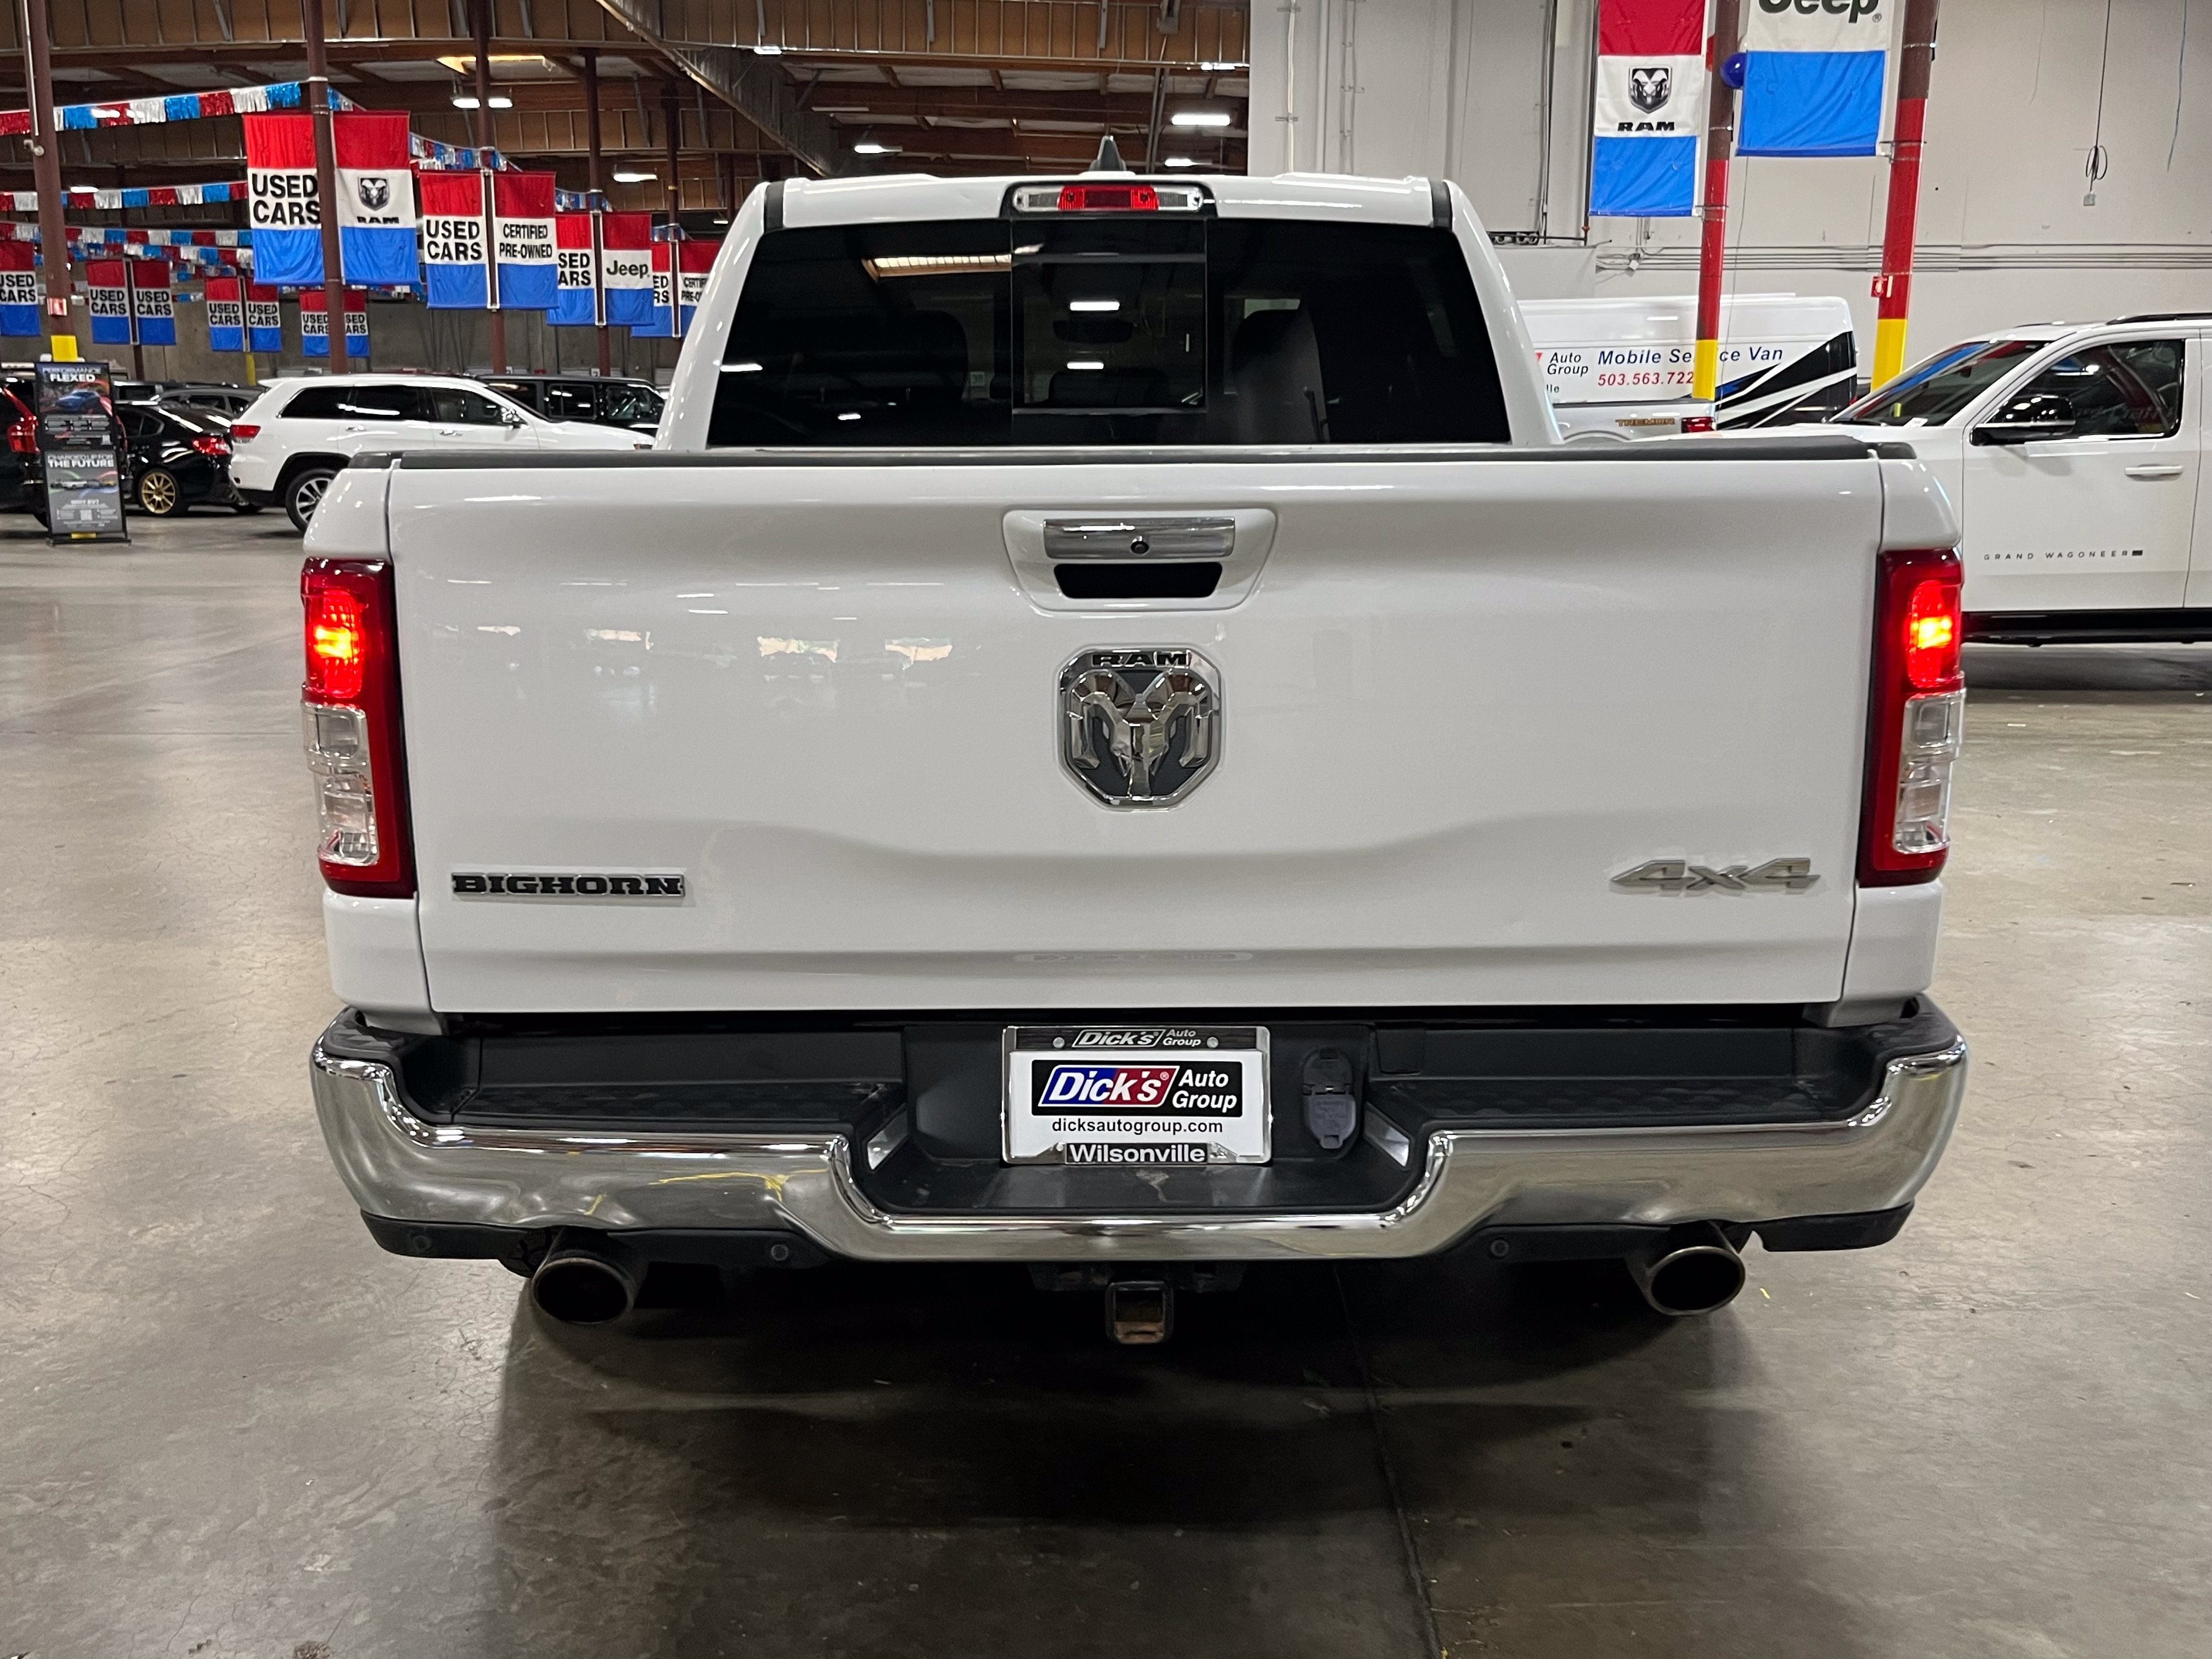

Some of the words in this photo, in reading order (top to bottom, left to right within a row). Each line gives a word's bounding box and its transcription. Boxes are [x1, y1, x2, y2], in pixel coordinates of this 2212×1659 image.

[1618, 122, 1675, 132] RAM
[252, 173, 318, 198] USED
[253, 200, 320, 225] CARS
[426, 219, 480, 240] USED
[503, 223, 548, 239] CERTIFIED
[427, 240, 482, 261] CARS
[499, 242, 552, 258] PRE-OWNED
[558, 252, 590, 269] SED
[606, 260, 648, 279] Jeep
[558, 270, 591, 286] ARS
[653, 275, 669, 289] ED
[684, 277, 708, 288] CERTIF
[0, 289, 36, 302] CARS
[91, 289, 125, 302] USED
[137, 290, 169, 302] USED
[653, 290, 669, 303] RS
[91, 302, 126, 315] CARS
[137, 303, 172, 315] CARS
[209, 303, 239, 314] USED
[249, 304, 278, 315] USED
[210, 315, 241, 326] CARS
[249, 315, 279, 326] CARS
[303, 314, 328, 324] USED
[346, 314, 365, 324] SED
[345, 325, 366, 334] ARS
[1549, 352, 1582, 363] Auto
[1598, 350, 1662, 365] Mobile
[1669, 348, 1741, 363] Sece
[1749, 346, 1783, 361] Van
[1547, 364, 1589, 377] Group
[50, 374, 95, 382] FLEXED
[1598, 371, 1694, 386] 503.563.722
[1615, 418, 1675, 427] TREMOR
[71, 459, 114, 467] FUTURE
[2045, 550, 2128, 558] WAGONEER
[1091, 652, 1189, 667] RAM
[451, 872, 685, 896] BIGHORN
[1163, 1037, 1201, 1047] Group
[1178, 1069, 1228, 1087] Auto
[1172, 1090, 1238, 1113] Group
[1052, 1118, 1223, 1135] dicksautogroup.com
[1069, 1144, 1206, 1163] Wilsonville
